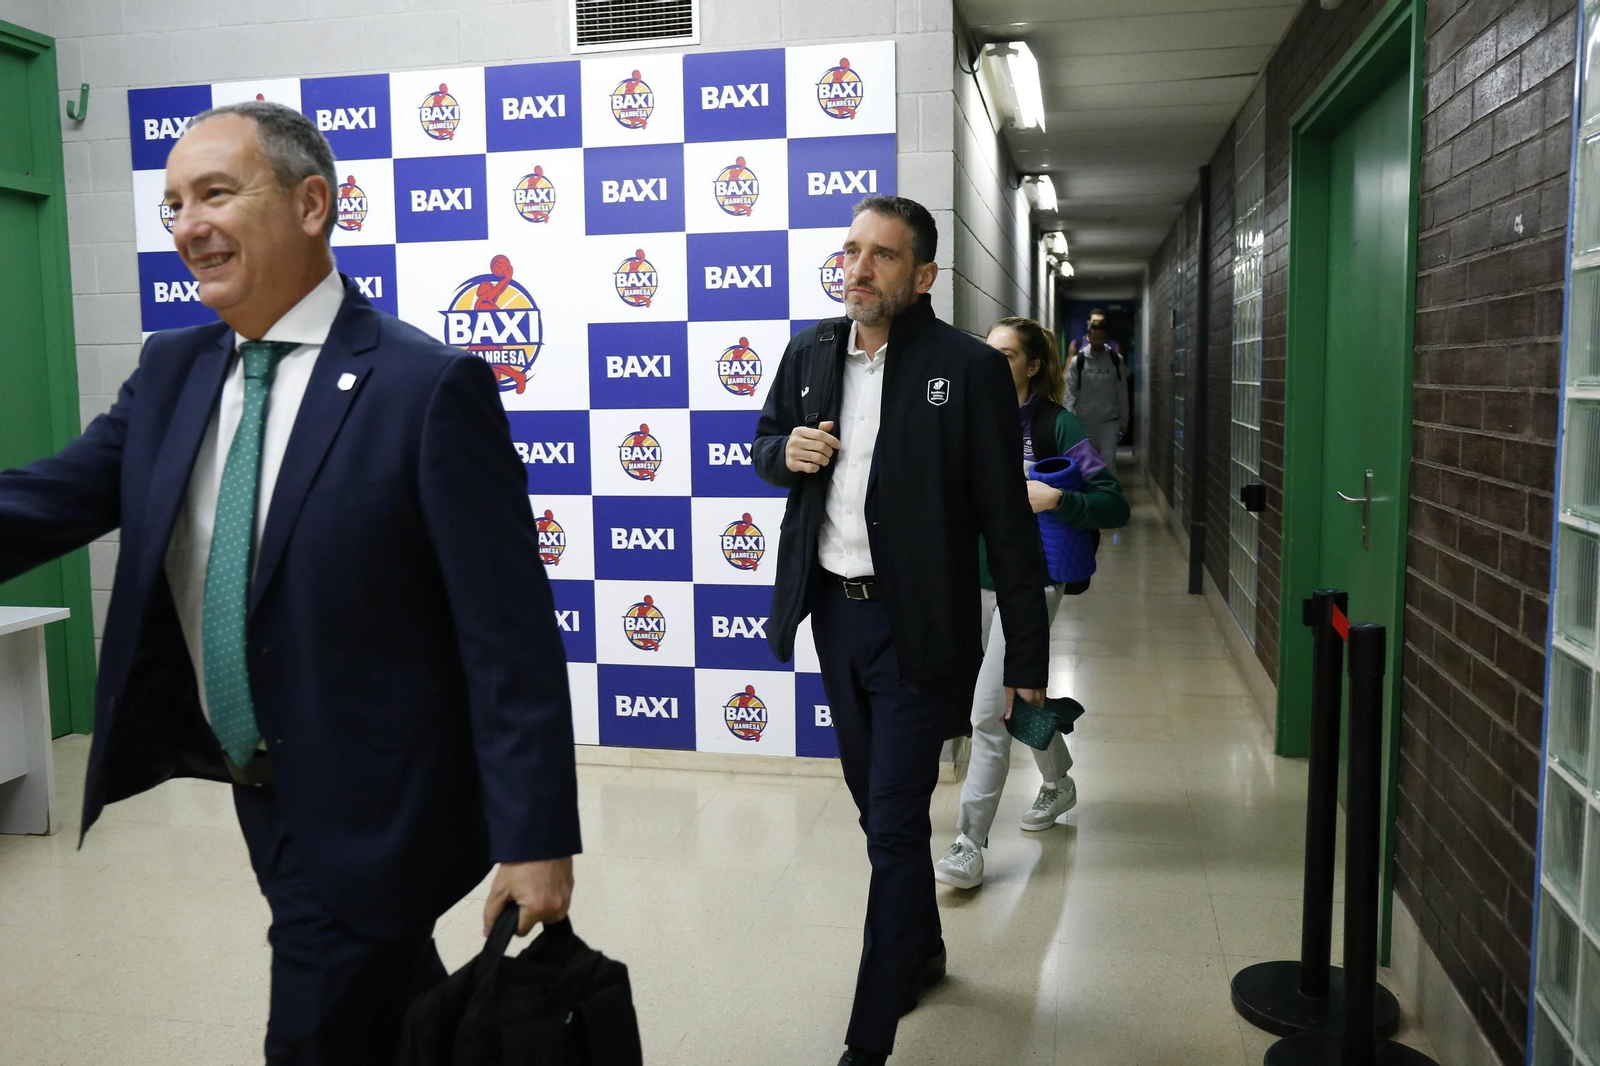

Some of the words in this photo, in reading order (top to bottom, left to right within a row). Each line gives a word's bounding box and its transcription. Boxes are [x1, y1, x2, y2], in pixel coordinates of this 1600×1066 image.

[701, 83, 769, 110] BAXI
[818, 82, 862, 99] BAXI
[502, 94, 565, 121] BAXI
[612, 93, 653, 109] BAXI
[827, 100, 855, 108] MANRESA
[316, 107, 376, 132] BAXI
[421, 106, 459, 121] BAXI
[620, 110, 647, 118] MANRESA
[143, 115, 196, 141] BAX
[428, 122, 453, 130] MANRESA
[716, 180, 758, 196] BAXI
[807, 169, 877, 196] BAXI
[515, 188, 555, 203] BAXI
[601, 178, 667, 204] BAXI
[410, 188, 473, 213] BAXI
[723, 197, 750, 205] MANRESA
[523, 205, 549, 213] MANRESA
[616, 272, 657, 287] BAXI
[704, 265, 771, 290] BAXI
[821, 267, 845, 282] BA
[154, 280, 201, 303] BAX
[355, 276, 382, 299] XI
[624, 289, 650, 297] MANRESA
[447, 310, 540, 344] BAXI
[606, 354, 671, 379] BAXI
[720, 360, 760, 375] BAXI
[727, 377, 754, 385] MANRESA
[621, 446, 660, 460] BAXI
[629, 462, 654, 470] MANRESA
[538, 532, 564, 546] AXI
[611, 527, 675, 550] BAXI
[723, 536, 763, 550] BAXI
[539, 547, 559, 555] ANRESA
[730, 552, 757, 560] MANRESA
[555, 611, 580, 632] XI
[625, 617, 664, 631] BAXI
[712, 615, 768, 639] BAX
[633, 632, 658, 640] MANRESA
[615, 695, 679, 719] BAXI
[725, 707, 766, 721] BAXI
[733, 723, 760, 731] MANRESA
